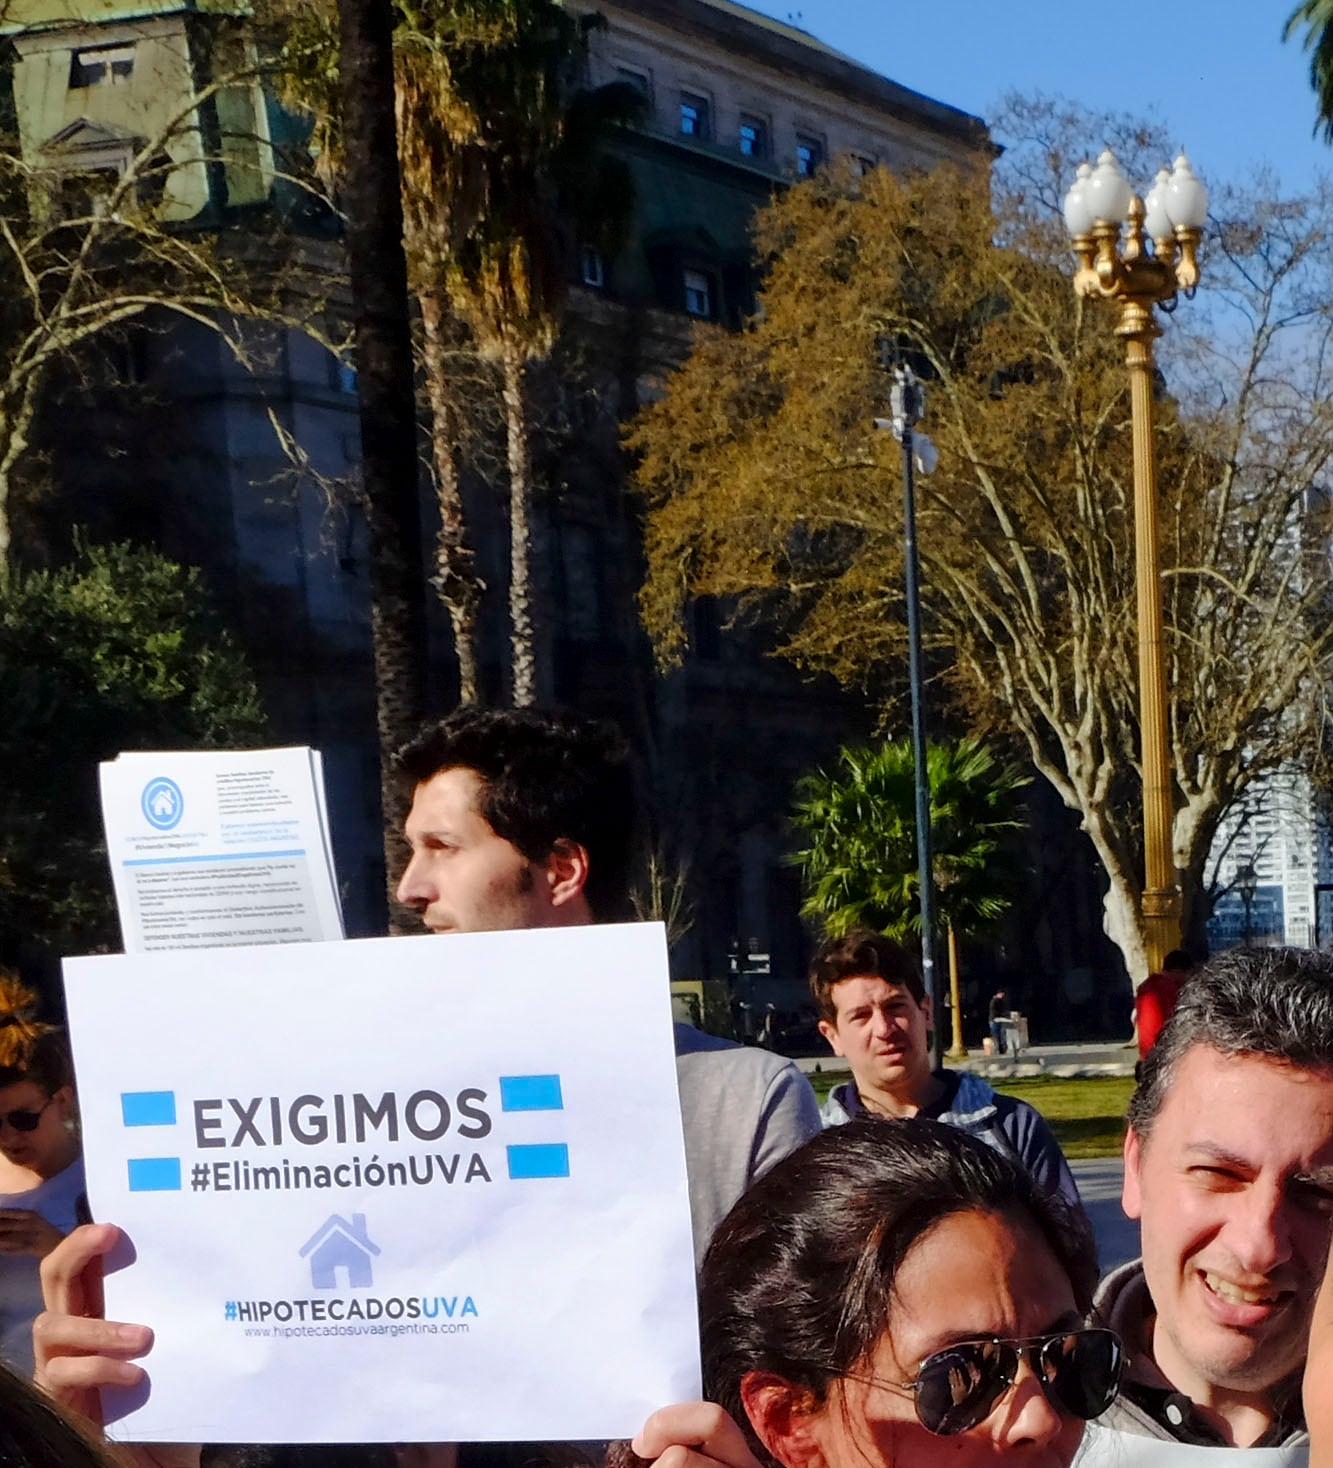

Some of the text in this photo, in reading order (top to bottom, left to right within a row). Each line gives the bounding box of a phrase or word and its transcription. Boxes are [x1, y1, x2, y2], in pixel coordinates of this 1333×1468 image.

[193, 1087, 493, 1149] EXIGIMOS
[190, 1152, 493, 1192] #EliminaciónUVA
[224, 1295, 479, 1323] #HIPOTECADOSUVA
[244, 1320, 470, 1339] www.hipotecadosuvaargentina.com
